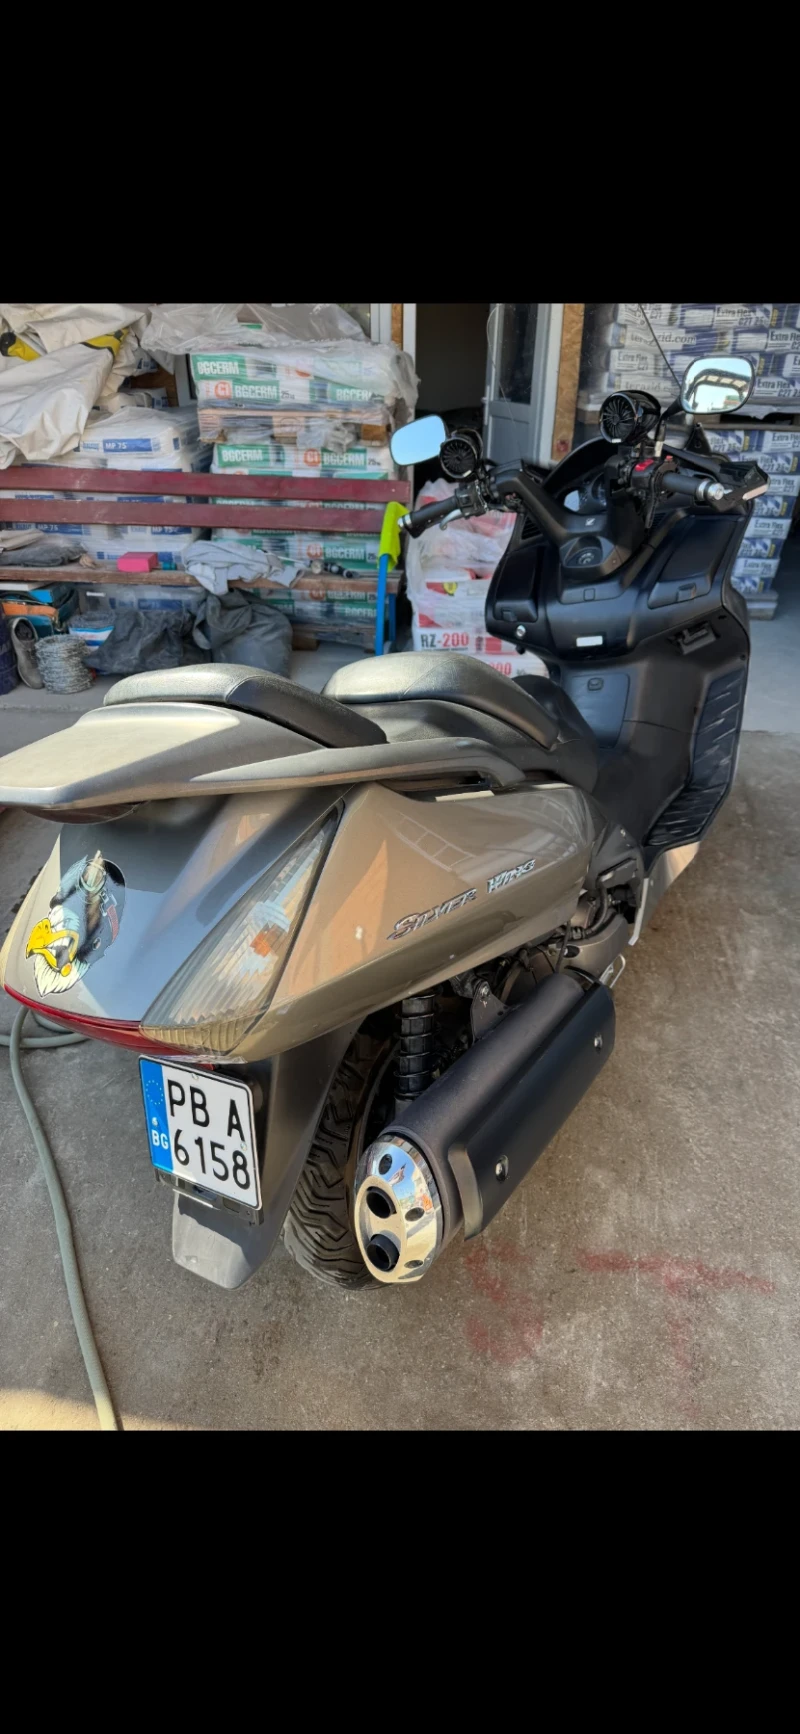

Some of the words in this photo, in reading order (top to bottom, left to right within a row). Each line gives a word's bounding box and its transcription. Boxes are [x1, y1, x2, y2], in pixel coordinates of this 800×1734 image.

[771, 331, 788, 341] Extra
[757, 379, 776, 389] Extra
[235, 385, 278, 399] BGCERM
[105, 442, 117, 450] MP
[118, 442, 128, 450] 75
[222, 450, 263, 462] BGCERM
[323, 452, 365, 466] BGCERM
[420, 632, 470, 648] RZ-200
[386, 887, 477, 940] SILVER
[487, 858, 536, 893] WING
[167, 1079, 210, 1128] PB
[227, 1098, 245, 1142] A
[151, 1129, 169, 1150] BG
[174, 1128, 251, 1191] 6158
